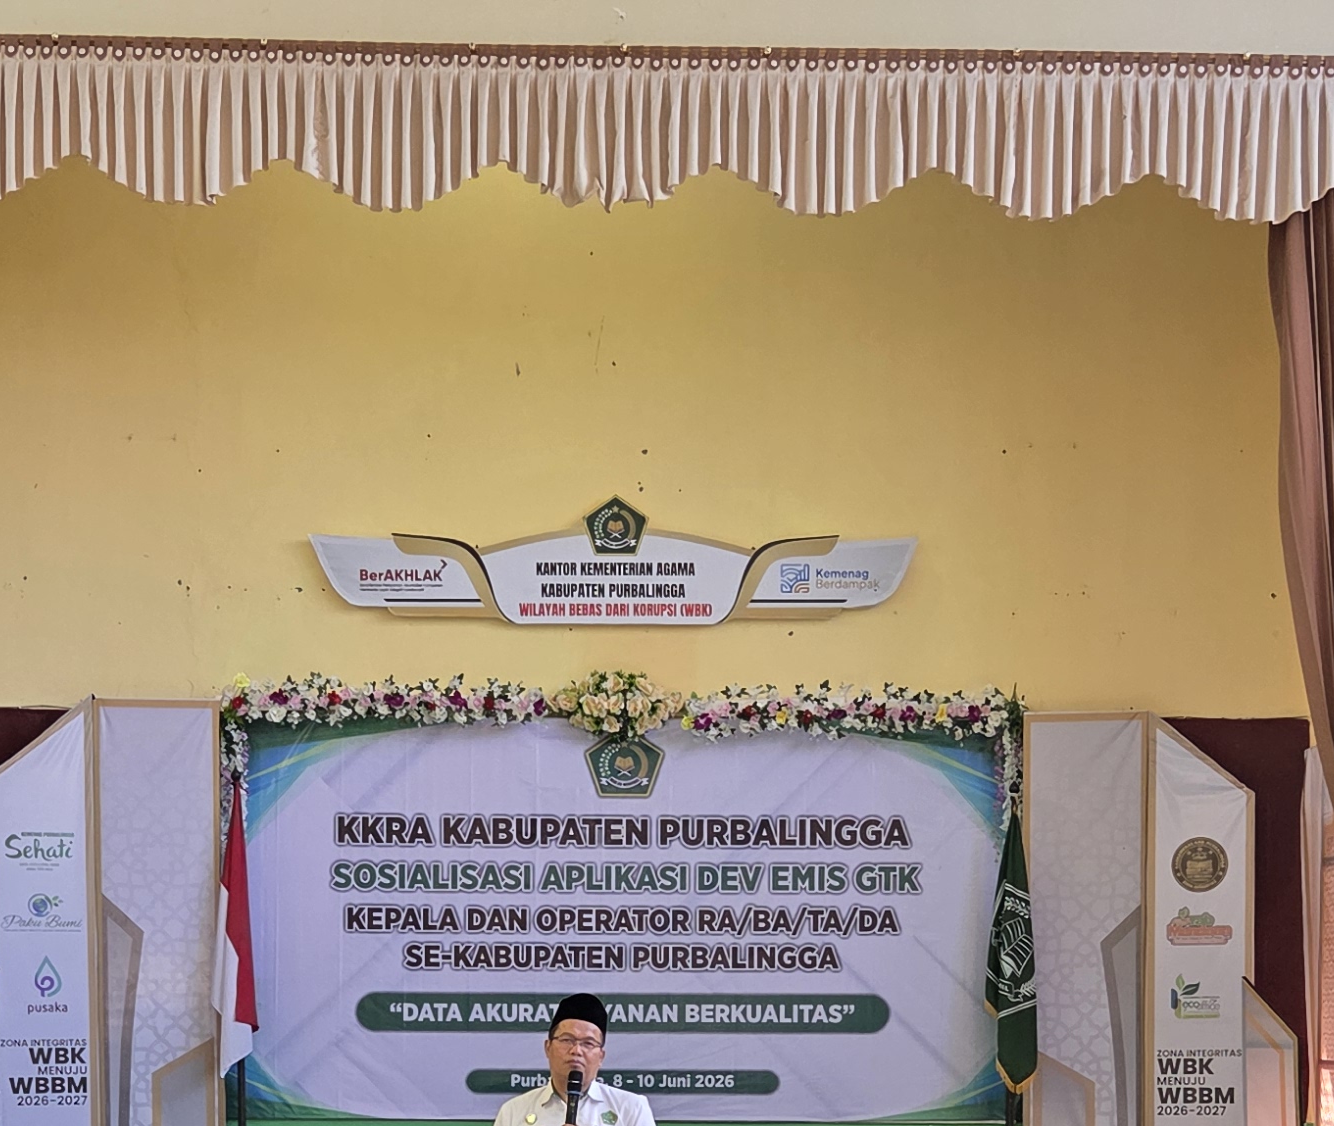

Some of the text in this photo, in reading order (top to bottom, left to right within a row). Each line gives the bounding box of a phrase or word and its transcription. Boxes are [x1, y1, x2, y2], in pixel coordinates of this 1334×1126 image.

[359, 567, 444, 582] BerAKHLAK
[536, 562, 696, 577] KANTOR KEMENTERIAN AGAMA
[815, 568, 870, 581] Kemenag
[541, 583, 686, 599] KABUPATEN PURBALINGGA
[815, 579, 881, 591] Berdampak
[518, 603, 713, 617] WILAYAH BEBAS DARI KORUPSI (WBK)
[336, 814, 911, 849] KKRA KABUPATEN PURBALINGGA
[4, 833, 73, 861] Sehati
[331, 863, 922, 895] SOSIALISASI APLIKASI DEV EMIS GTK
[0, 914, 83, 930] Paku Bumi
[346, 905, 899, 937] KEPALA DAN OPERATOR RA/BA/TA/DA
[404, 943, 841, 973] SE-KABUPATEN PURBALINGGA
[27, 1001, 69, 1015] pusaka
[0, 1038, 87, 1048] ZONA INTEGRITAS
[28, 1047, 86, 1065] WBK
[1156, 1049, 1242, 1058] ZONA INTEGRITAS
[37, 1065, 87, 1076] MENUJU
[1157, 1057, 1214, 1075] WBK
[8, 1076, 87, 1095] WBBM
[612, 1073, 623, 1088] 8
[636, 1073, 658, 1088] 10
[661, 1073, 691, 1089] Juni
[694, 1073, 735, 1088] 2026
[1156, 1076, 1206, 1086] MENUJU
[16, 1095, 88, 1107] 2026-2027
[1157, 1086, 1235, 1104] WBBM
[1157, 1105, 1227, 1116] 2026-2027
